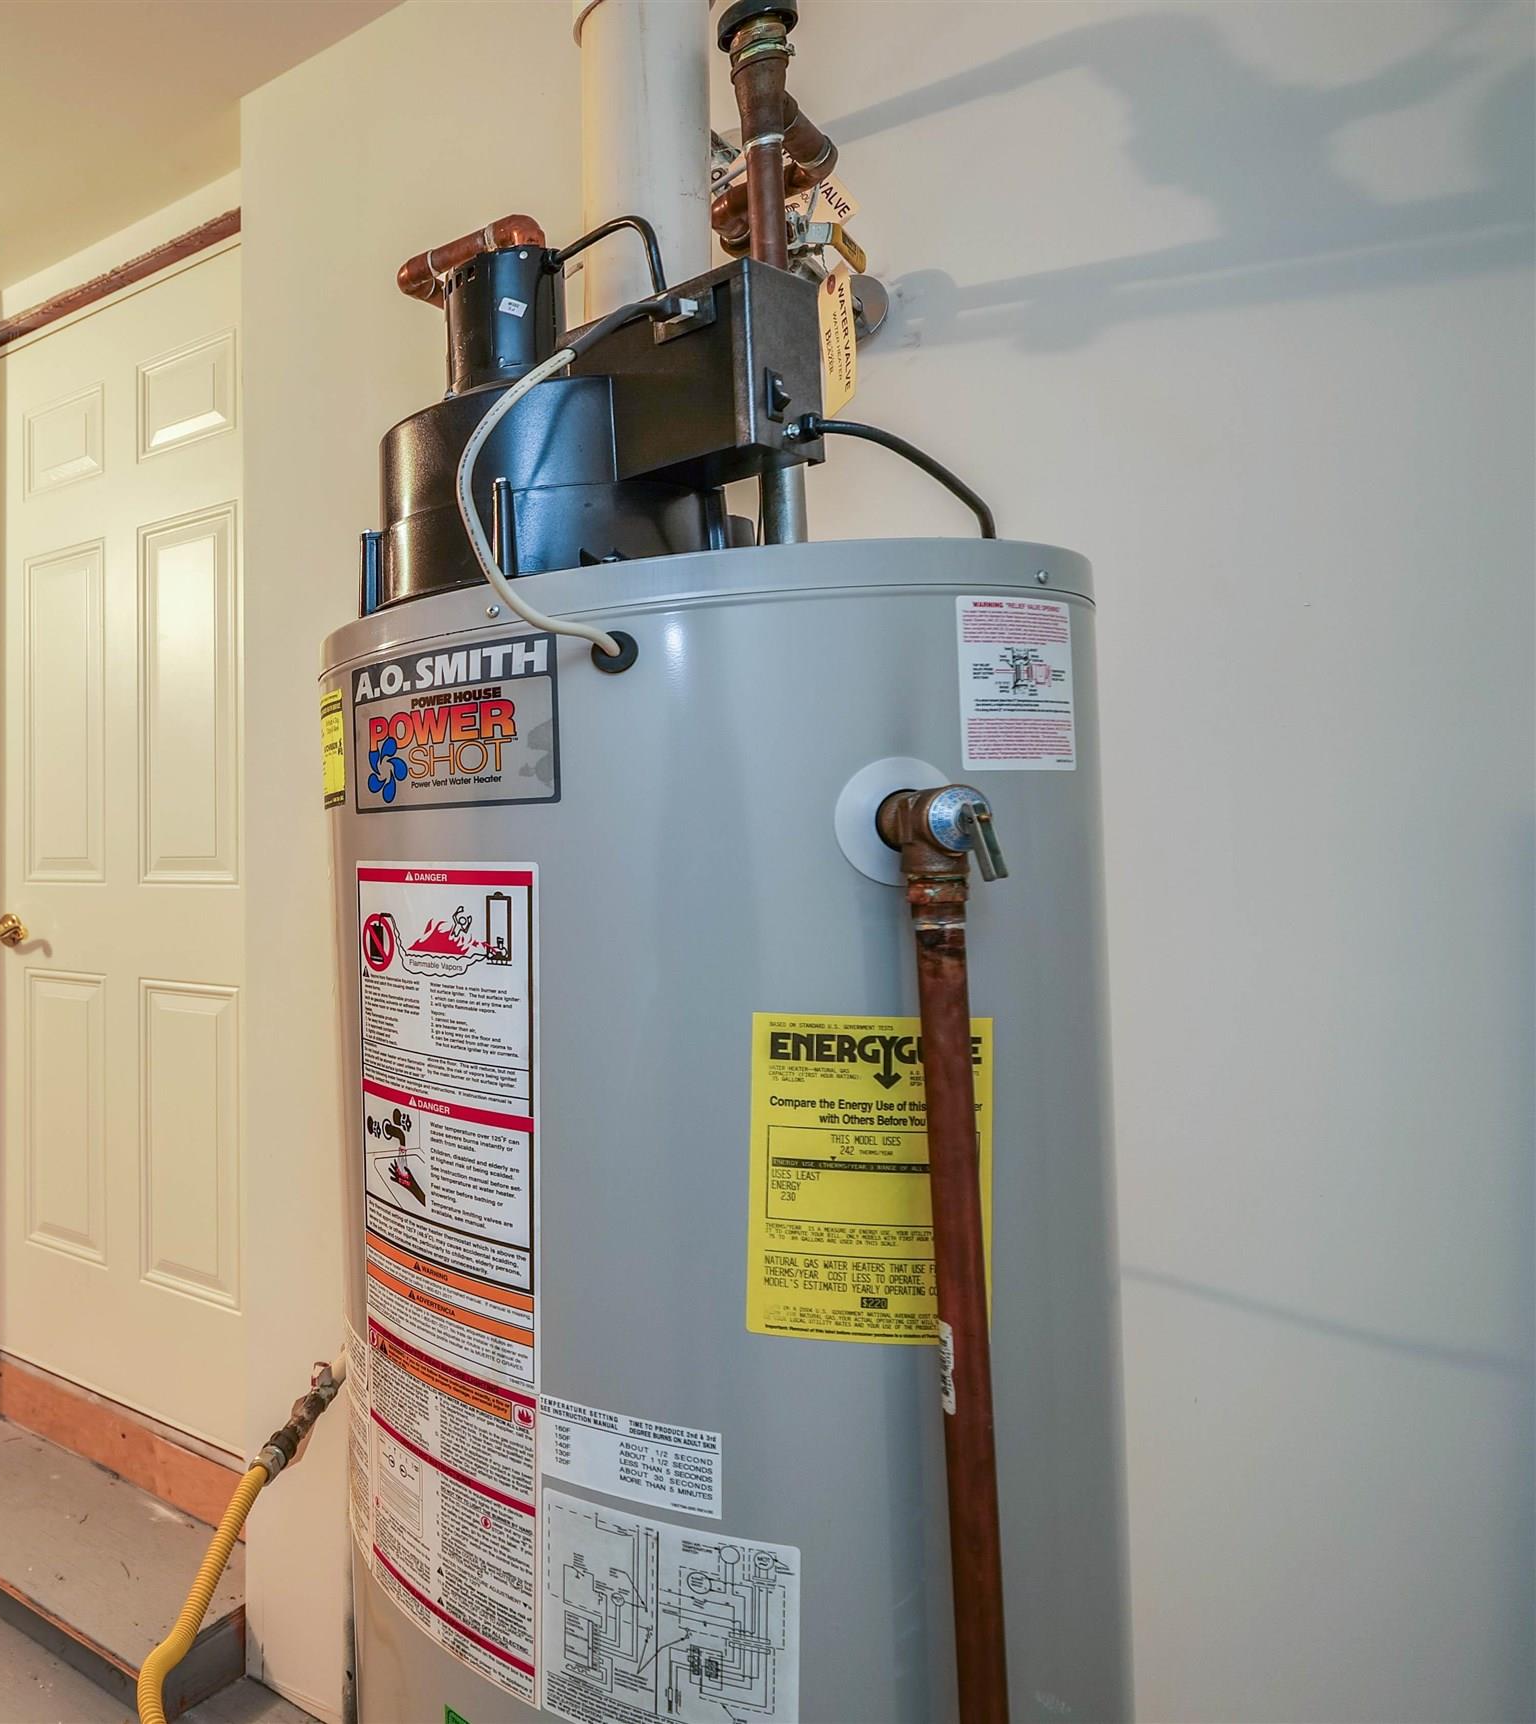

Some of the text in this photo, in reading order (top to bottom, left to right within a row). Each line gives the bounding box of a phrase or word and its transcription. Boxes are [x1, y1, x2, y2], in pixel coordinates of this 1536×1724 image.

[819, 181, 851, 218] VALVE
[838, 283, 852, 392] WATER VALVE
[355, 639, 548, 702] A.O. SMITH
[411, 687, 502, 709] POWER HOUSE
[369, 699, 517, 751] POWER
[409, 738, 512, 778] SHOT
[411, 775, 502, 789] Power Vent Water Heater
[414, 873, 448, 881] DANGER
[409, 959, 463, 972] Flammable Vapors
[417, 1100, 450, 1115] DANGER
[769, 1095, 927, 1113] Compare the Energy Use of this
[819, 1113, 926, 1127] with Others Before You
[831, 1134, 901, 1146] THIS MODEL USES
[840, 1145, 855, 1155] 242
[772, 1168, 821, 1181] USES LEAST
[771, 1180, 801, 1191] ENERGY
[781, 1191, 796, 1201] 230
[765, 1256, 926, 1274] NATURAL GAS WATER HEATERS THAT USE
[764, 1266, 819, 1280] THERMS/YEAR
[828, 1272, 848, 1281] COST
[852, 1273, 871, 1283] LESS
[876, 1274, 885, 1283] TO
[803, 1280, 848, 1292] ESTIMATED
[852, 1284, 880, 1294] YEARLY
[884, 1286, 925, 1296] OPERATING
[416, 1295, 455, 1316] ADVERTENCIA
[540, 1397, 619, 1423] TEMPERATURE SETTING
[540, 1404, 618, 1431] SEE INSTRUCTION MANUAL
[629, 1420, 643, 1429] TIME
[655, 1426, 684, 1437] PRODUCE
[629, 1428, 651, 1438] DEGREE
[653, 1432, 672, 1442] BURNS
[683, 1439, 701, 1447] ADULT
[619, 1442, 713, 1466] ABOUT 1/2 SECOND
[619, 1450, 646, 1461] ABOUT
[673, 1462, 713, 1475] SECONDS
[619, 1458, 638, 1468] LESS
[642, 1463, 663, 1473] THAN
[674, 1470, 713, 1483] SECONDS
[619, 1467, 713, 1492] ABOUT 30 SECONDS
[619, 1474, 642, 1486] MORE
[645, 1481, 666, 1491] THAN
[678, 1488, 713, 1500] MINUTES
